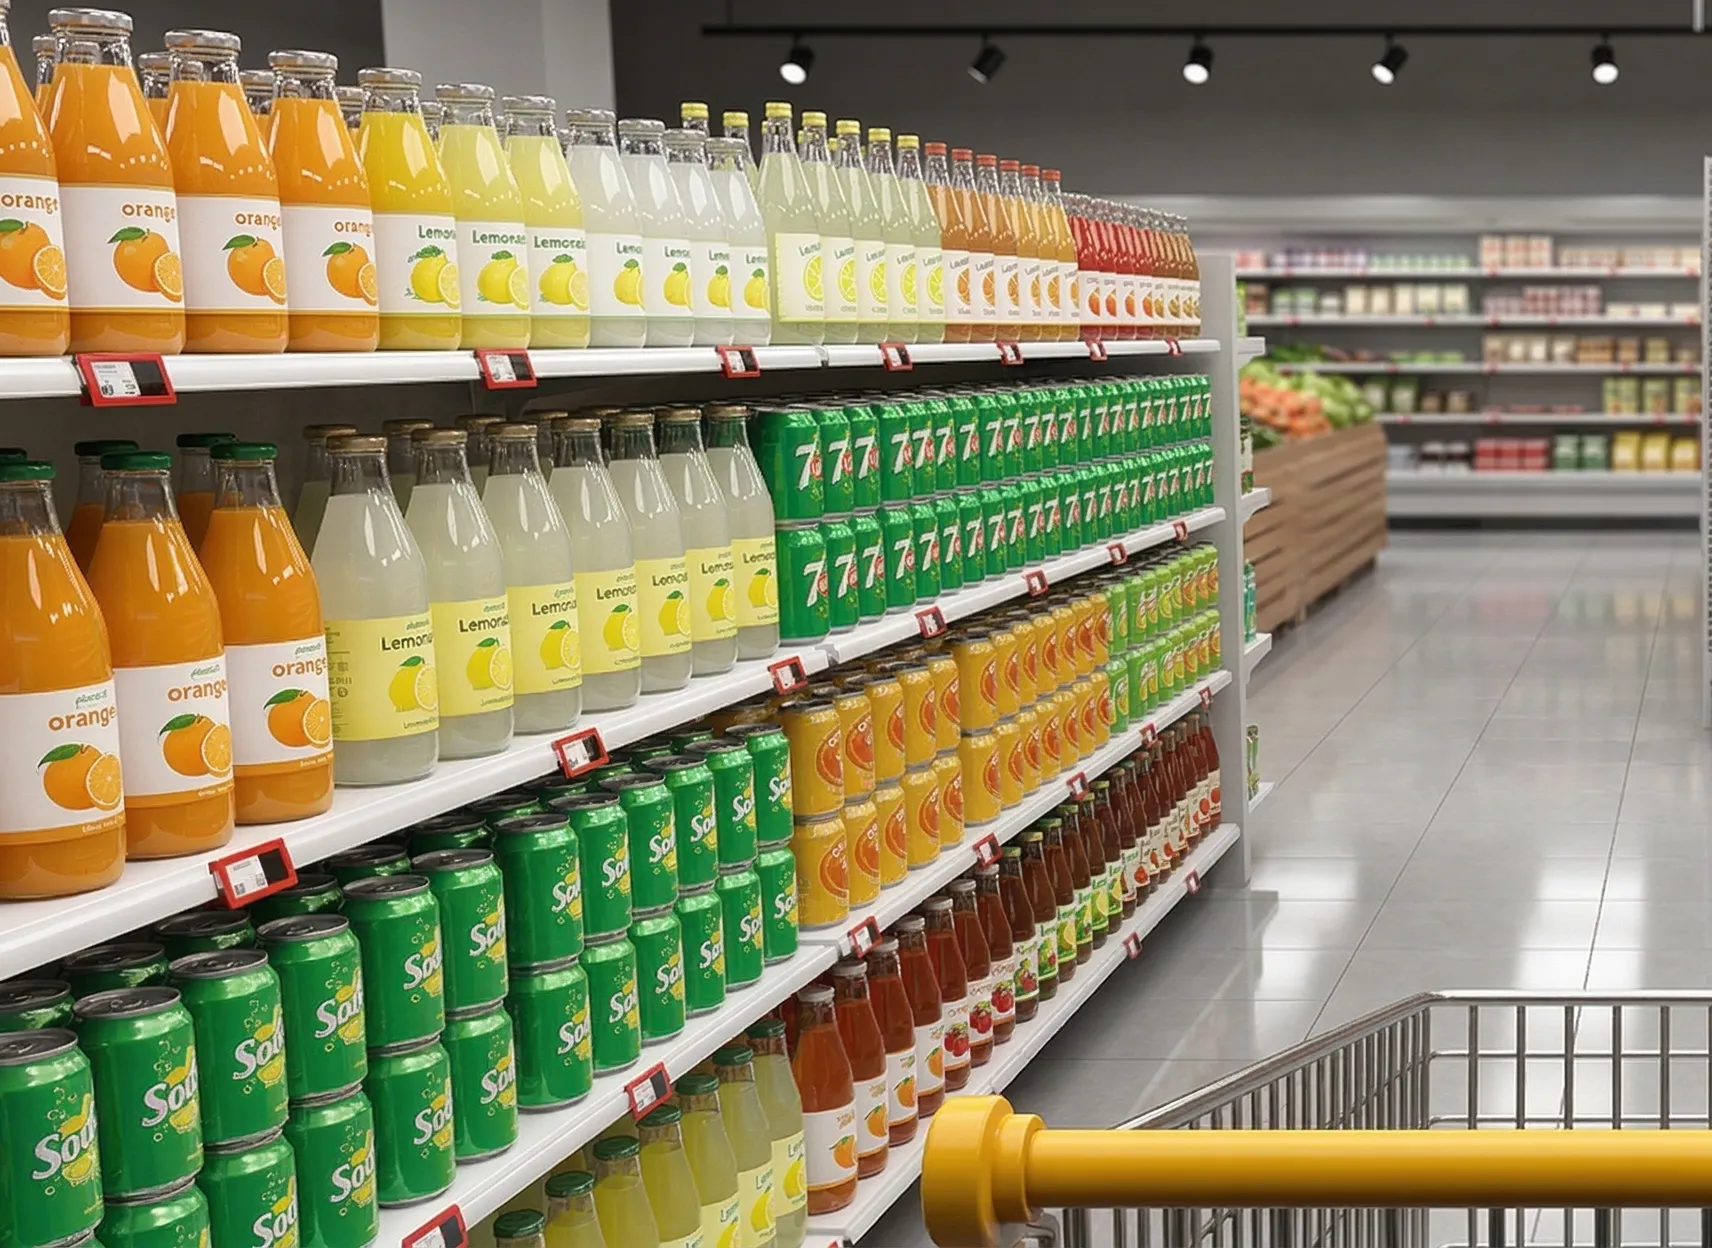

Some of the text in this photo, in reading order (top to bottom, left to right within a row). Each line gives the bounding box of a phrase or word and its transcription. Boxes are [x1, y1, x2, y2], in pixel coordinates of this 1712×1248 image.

[404, 944, 441, 990] Sod
[315, 983, 362, 1039] Sod
[232, 1024, 285, 1080] Sod
[142, 1063, 199, 1127] Sod
[33, 1112, 97, 1180] Sod
[413, 1101, 454, 1145] Sod
[329, 1150, 375, 1203] Sod
[253, 1196, 298, 1248] Sod
